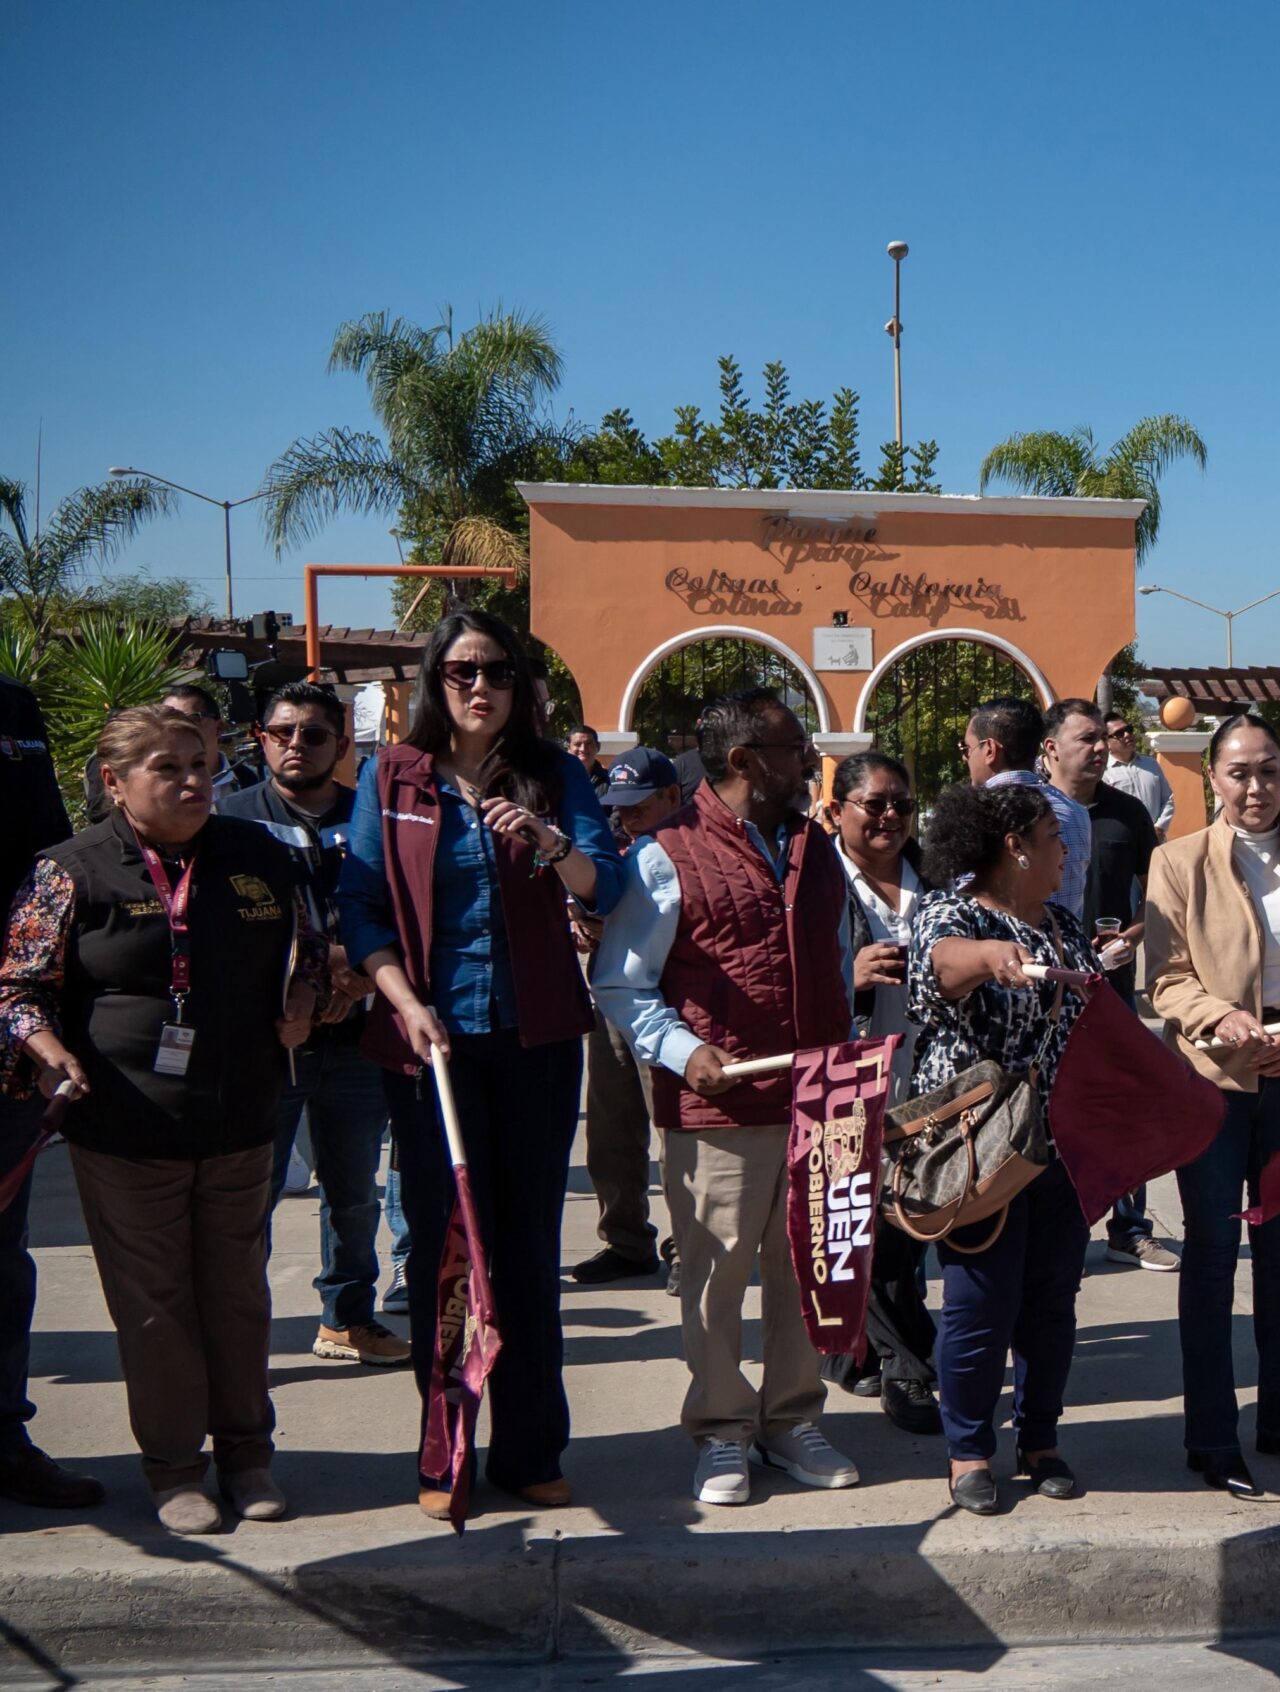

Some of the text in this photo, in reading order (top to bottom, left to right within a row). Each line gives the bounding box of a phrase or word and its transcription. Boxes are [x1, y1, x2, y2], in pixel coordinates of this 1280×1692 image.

[665, 567, 779, 594] Colinas
[848, 571, 1001, 607] California
[237, 905, 281, 919] TIJUANA
[808, 1120, 829, 1285] GOBIERNO
[850, 1172, 872, 1246] UN
